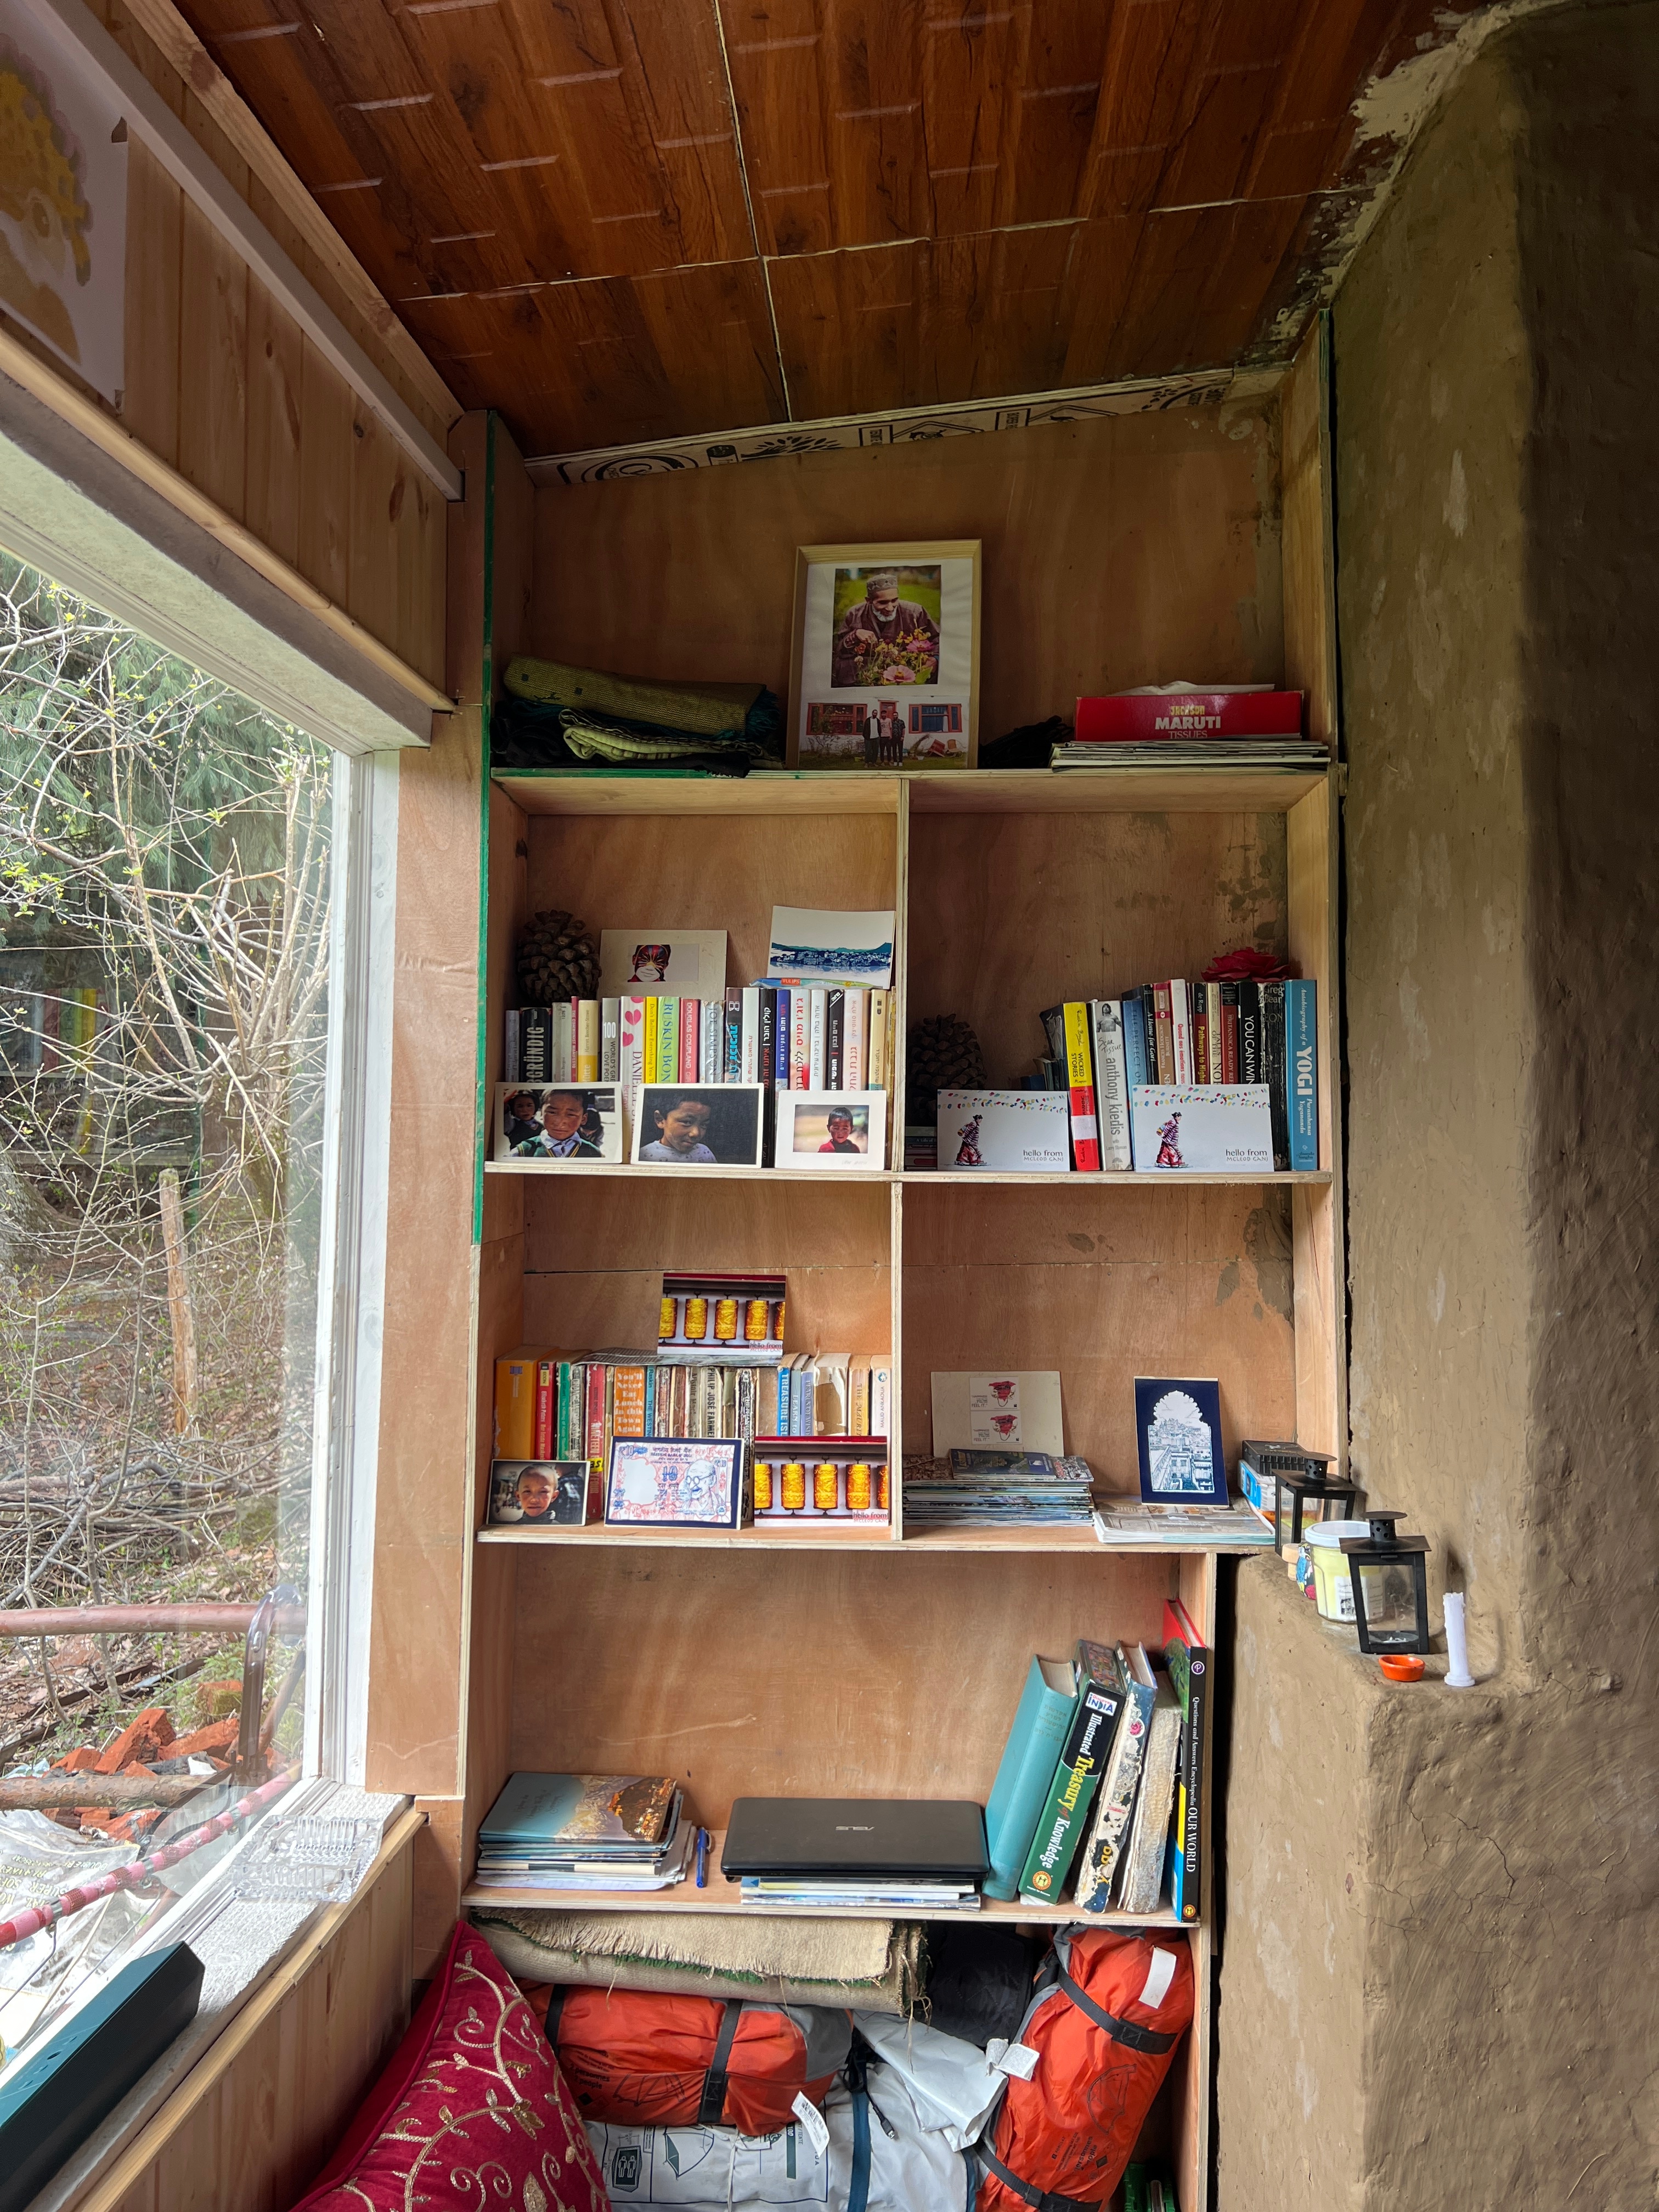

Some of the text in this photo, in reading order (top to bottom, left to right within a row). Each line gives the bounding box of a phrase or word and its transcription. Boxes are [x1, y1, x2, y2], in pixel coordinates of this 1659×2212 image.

[1170, 706, 1205, 716] JACKSON
[1155, 716, 1221, 730] MARUTI
[1168, 730, 1208, 739] TISSUES
[1265, 995, 1282, 1003] Bear
[1300, 988, 1308, 1032] Autobiography
[603, 1022, 616, 1039] 100
[1212, 1030, 1216, 1041] OF
[1244, 1015, 1254, 1037] YOU
[661, 1003, 673, 1082] RUSKIN BON
[709, 1007, 718, 1076] JOE SIMPSON
[1245, 1040, 1255, 1063] CAN
[523, 1026, 545, 1083] BGRÜNDIG
[794, 1051, 803, 1072] ללכת
[1198, 1065, 1206, 1084] Higher
[1296, 1046, 1313, 1095] YOGI
[1105, 1058, 1124, 1135] anthony kiedis
[1297, 1101, 1306, 1134] Yogananda
[707, 1368, 715, 1390] PHILIP
[707, 1392, 715, 1410] JOSÉ
[781, 1373, 789, 1420] TREASURE
[590, 1422, 600, 1453] NINETEEN
[1088, 1694, 1113, 1713] INDIA
[1079, 1713, 1103, 1756] Illustrated
[1057, 1755, 1095, 1812] Treasury
[1188, 1807, 1198, 1829] OUR
[1038, 1816, 1071, 1869] Knowledge
[1187, 1833, 1196, 1872] WORLD
